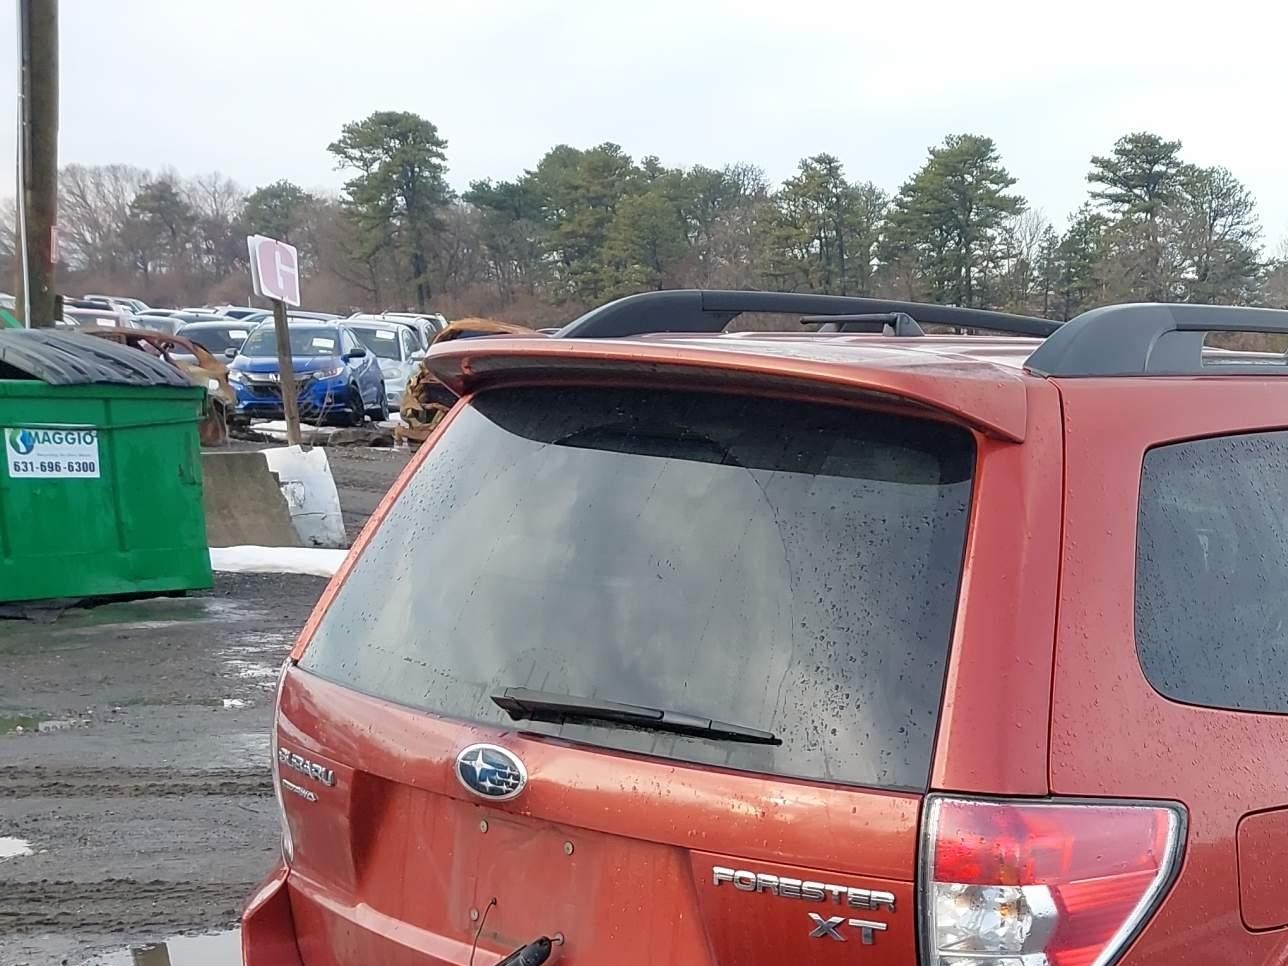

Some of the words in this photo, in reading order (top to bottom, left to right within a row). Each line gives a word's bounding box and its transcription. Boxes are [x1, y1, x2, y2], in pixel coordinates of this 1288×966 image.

[29, 431, 95, 446] MAGGIO
[13, 461, 96, 473] 631-696-6300
[279, 747, 334, 787] SUBARU
[712, 866, 897, 912] FORESTER
[807, 912, 888, 945] XT
